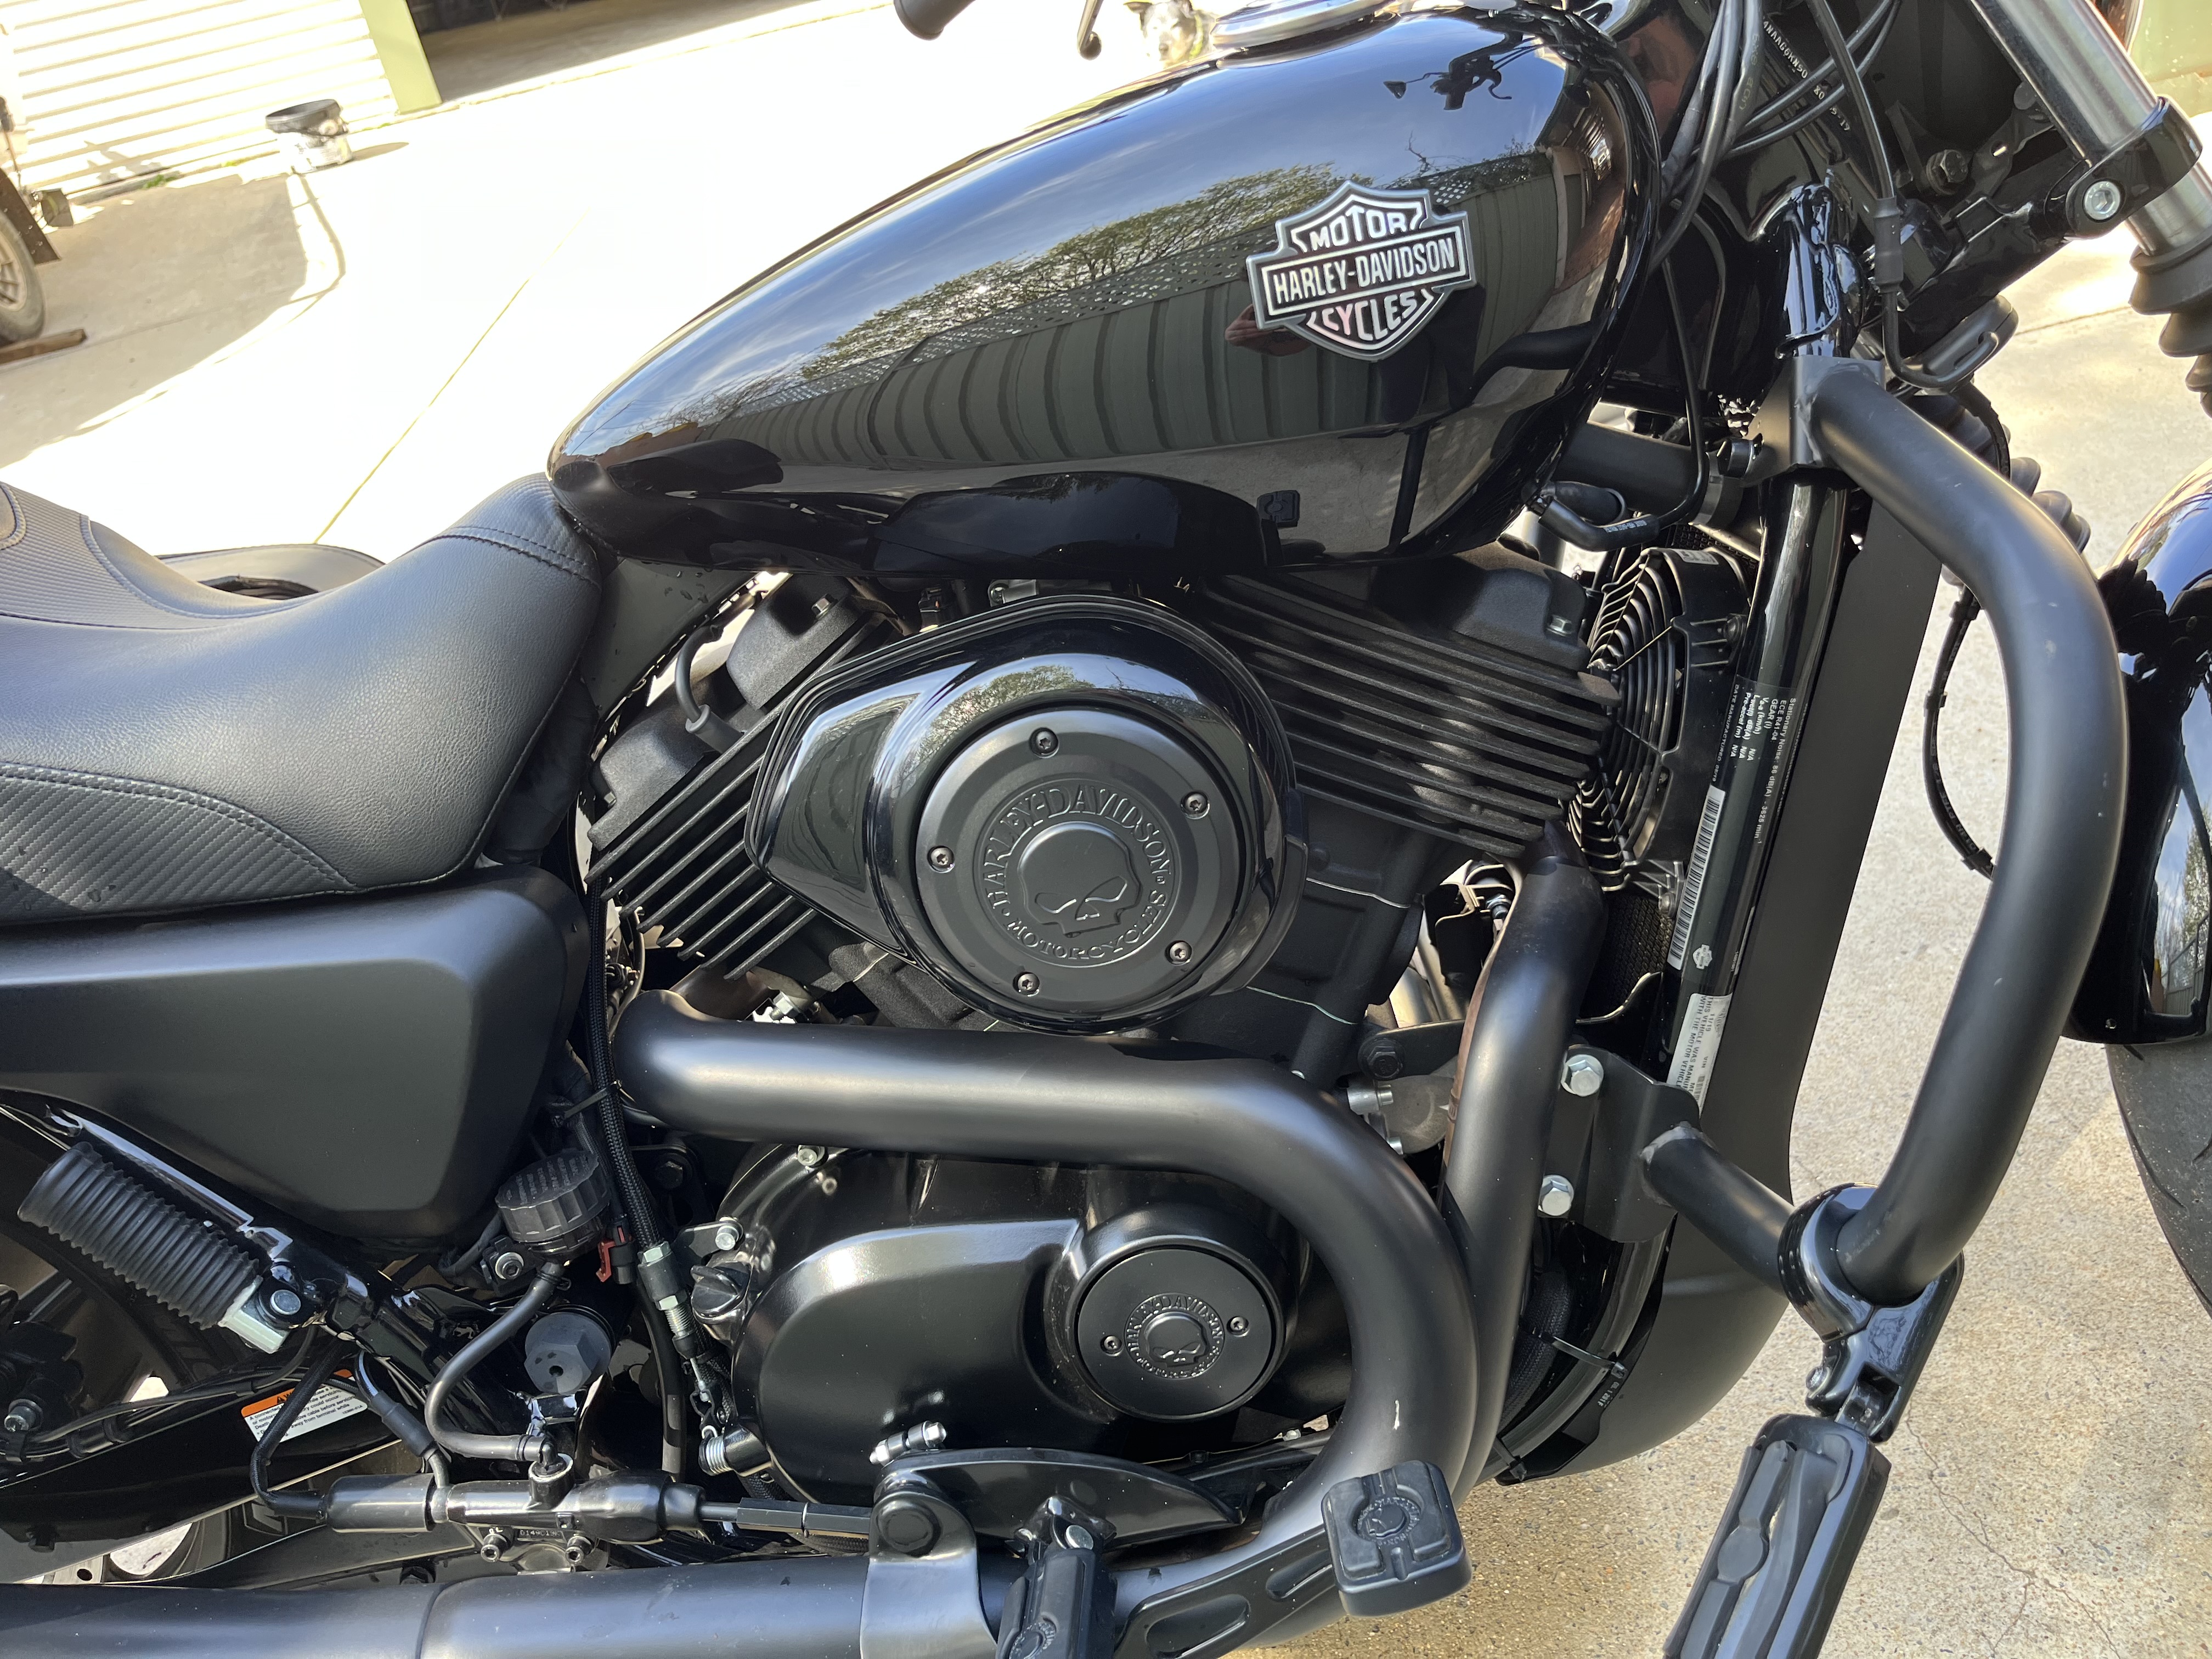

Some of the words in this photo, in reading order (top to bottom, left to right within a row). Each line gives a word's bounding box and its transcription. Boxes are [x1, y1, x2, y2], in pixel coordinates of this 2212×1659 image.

[1310, 205, 1407, 251] MOTOR
[1273, 238, 1455, 304] HARLEY-DAVIDSON
[1322, 290, 1417, 341] CYCLES
[1730, 684, 1740, 703] DATE
[1737, 691, 1751, 725] Pre-accel
[1767, 698, 1778, 720] GEAR
[1777, 699, 1786, 715] ECE
[1779, 697, 1796, 736] Stationary
[1716, 703, 1735, 761] MANUFACTURED
[1734, 725, 1743, 738] (m)
[1741, 719, 1754, 740] dB(A)
[1752, 711, 1765, 735] (km/h)
[1729, 744, 1739, 758] N/A
[1737, 745, 1747, 759] N/A
[1746, 748, 1756, 761] N/A
[984, 784, 1171, 910] HARLEY-DAVIDSON
[1696, 995, 1706, 1014] WITH
[1704, 996, 1713, 1013] THIS
[1691, 1017, 1700, 1030] THE
[1695, 1015, 1708, 1044] VEHICLE
[1705, 1013, 1714, 1032] 11/19
[1684, 1032, 1695, 1057] MOTOR
[1690, 1046, 1699, 1063] WAS
[310, 1400, 324, 1408] could
[315, 1408, 336, 1418] terminal
